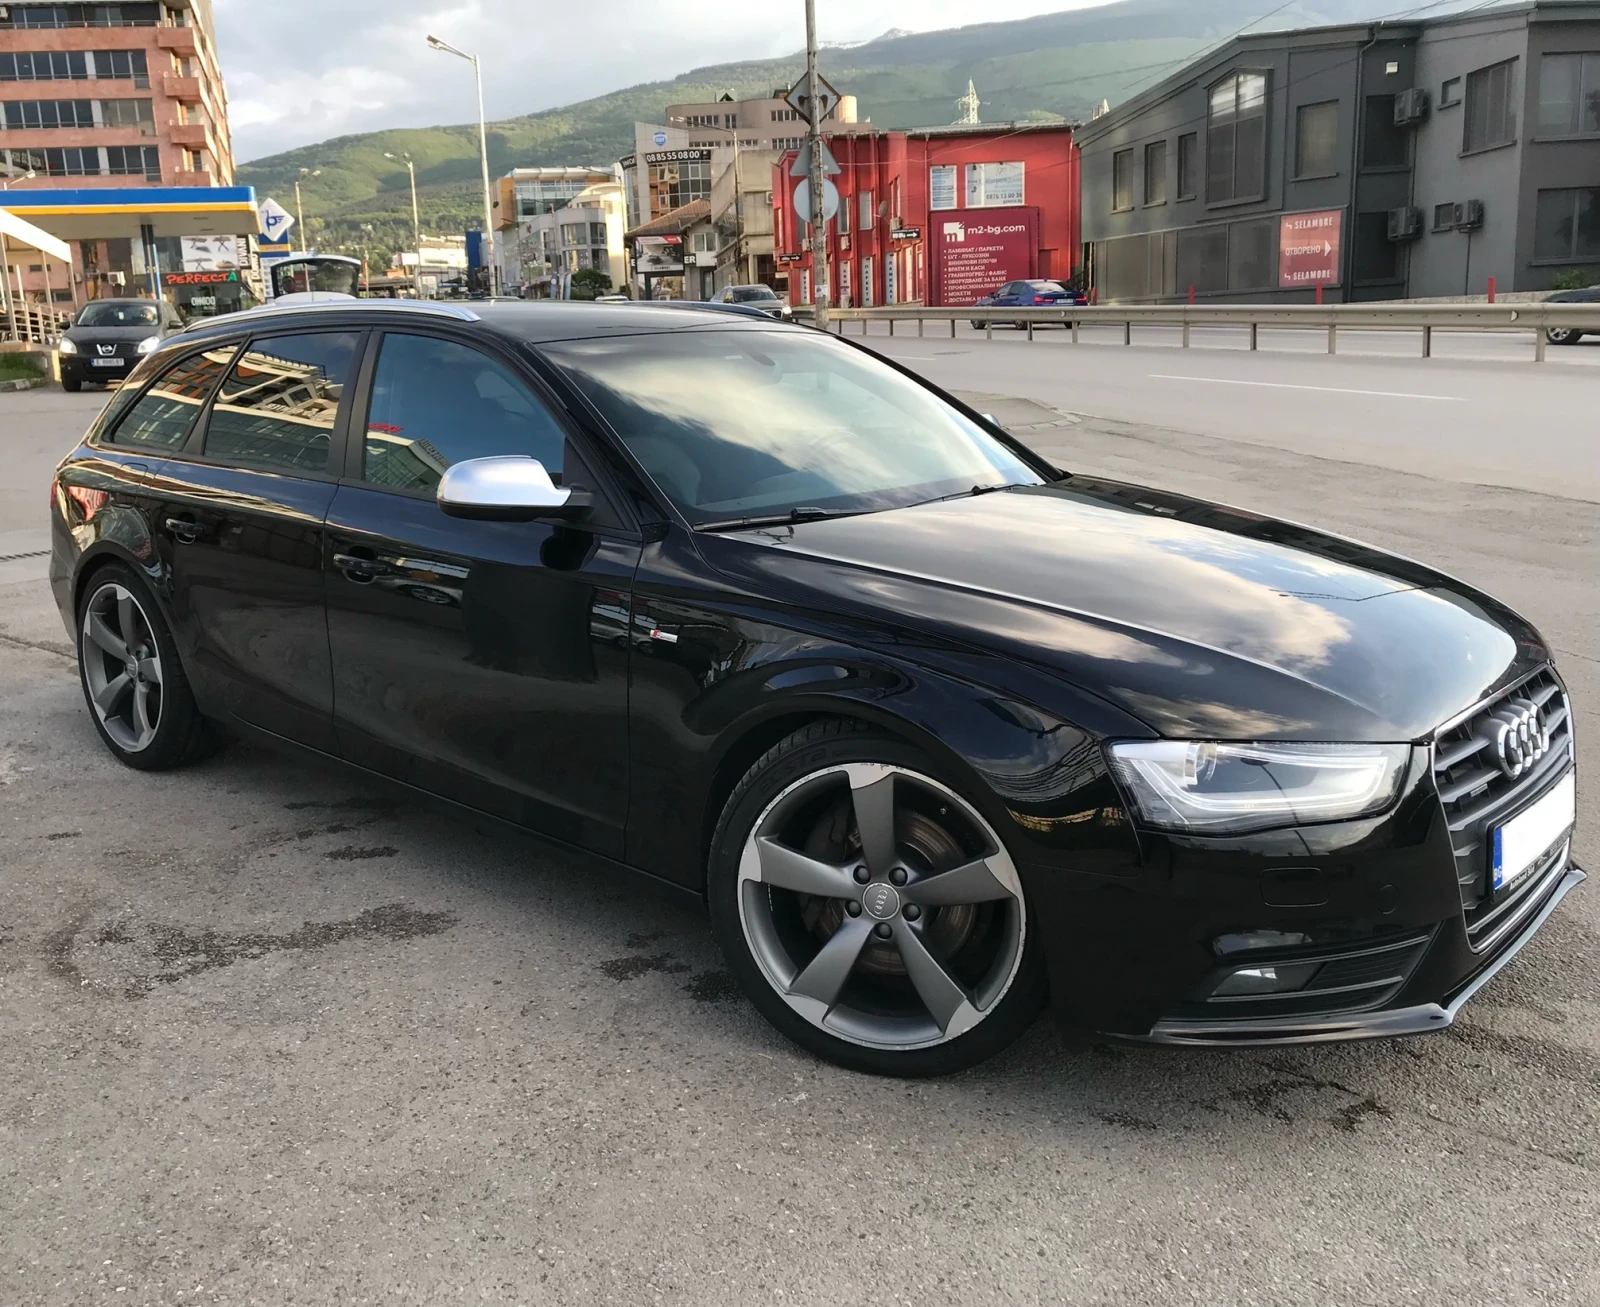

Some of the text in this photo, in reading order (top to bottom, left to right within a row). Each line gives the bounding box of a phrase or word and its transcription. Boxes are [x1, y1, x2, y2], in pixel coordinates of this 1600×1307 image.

[646, 153, 656, 163] 08
[656, 152, 666, 162] 85
[666, 152, 677, 161] 55
[677, 151, 688, 160] 08
[689, 150, 700, 159] 00
[1294, 216, 1333, 230] SELAMORE
[967, 224, 1026, 235] m2-bg.com
[237, 237, 247, 267] DIVANI
[1285, 245, 1321, 257] ОТВОРЕНО
[166, 270, 238, 285] PERFECTA
[1292, 269, 1331, 281] SELAMORE
[948, 283, 996, 291] ПРОФЕСИОНАЛНИ
[948, 296, 977, 304] ДОСТАВКА
[1493, 865, 1502, 882] BG
